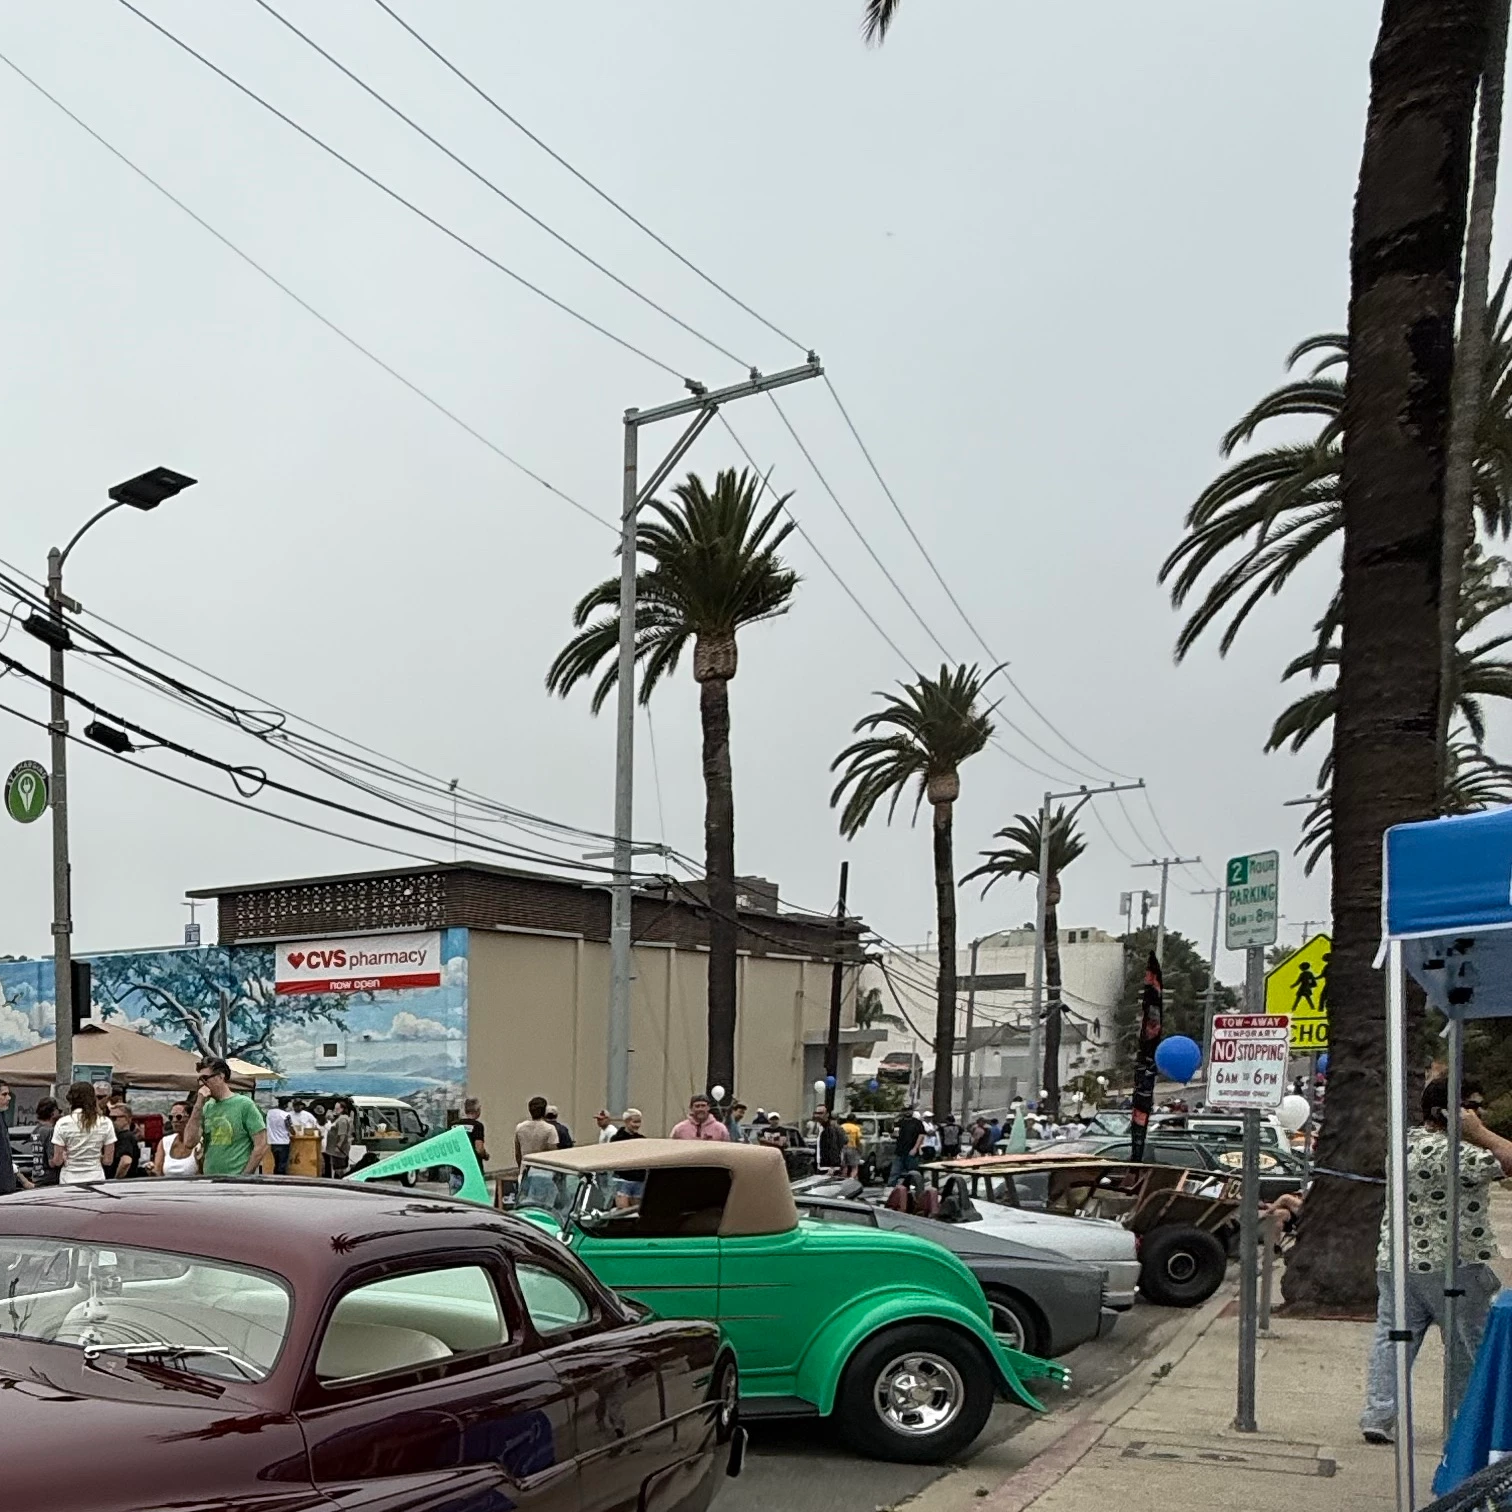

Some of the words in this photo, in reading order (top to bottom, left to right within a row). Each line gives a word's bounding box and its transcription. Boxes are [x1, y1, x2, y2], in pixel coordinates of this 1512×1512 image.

[1231, 862, 1243, 882] 2
[1229, 884, 1275, 907] PARKING
[306, 950, 346, 969] CVS
[349, 950, 427, 970] pharmacy
[330, 981, 351, 990] now
[354, 979, 380, 990] open
[1222, 1017, 1281, 1027] TOW-AWAY
[1223, 1029, 1278, 1037] TEMPORARY
[1215, 1042, 1235, 1061] NO
[1237, 1044, 1284, 1061] STOPPING
